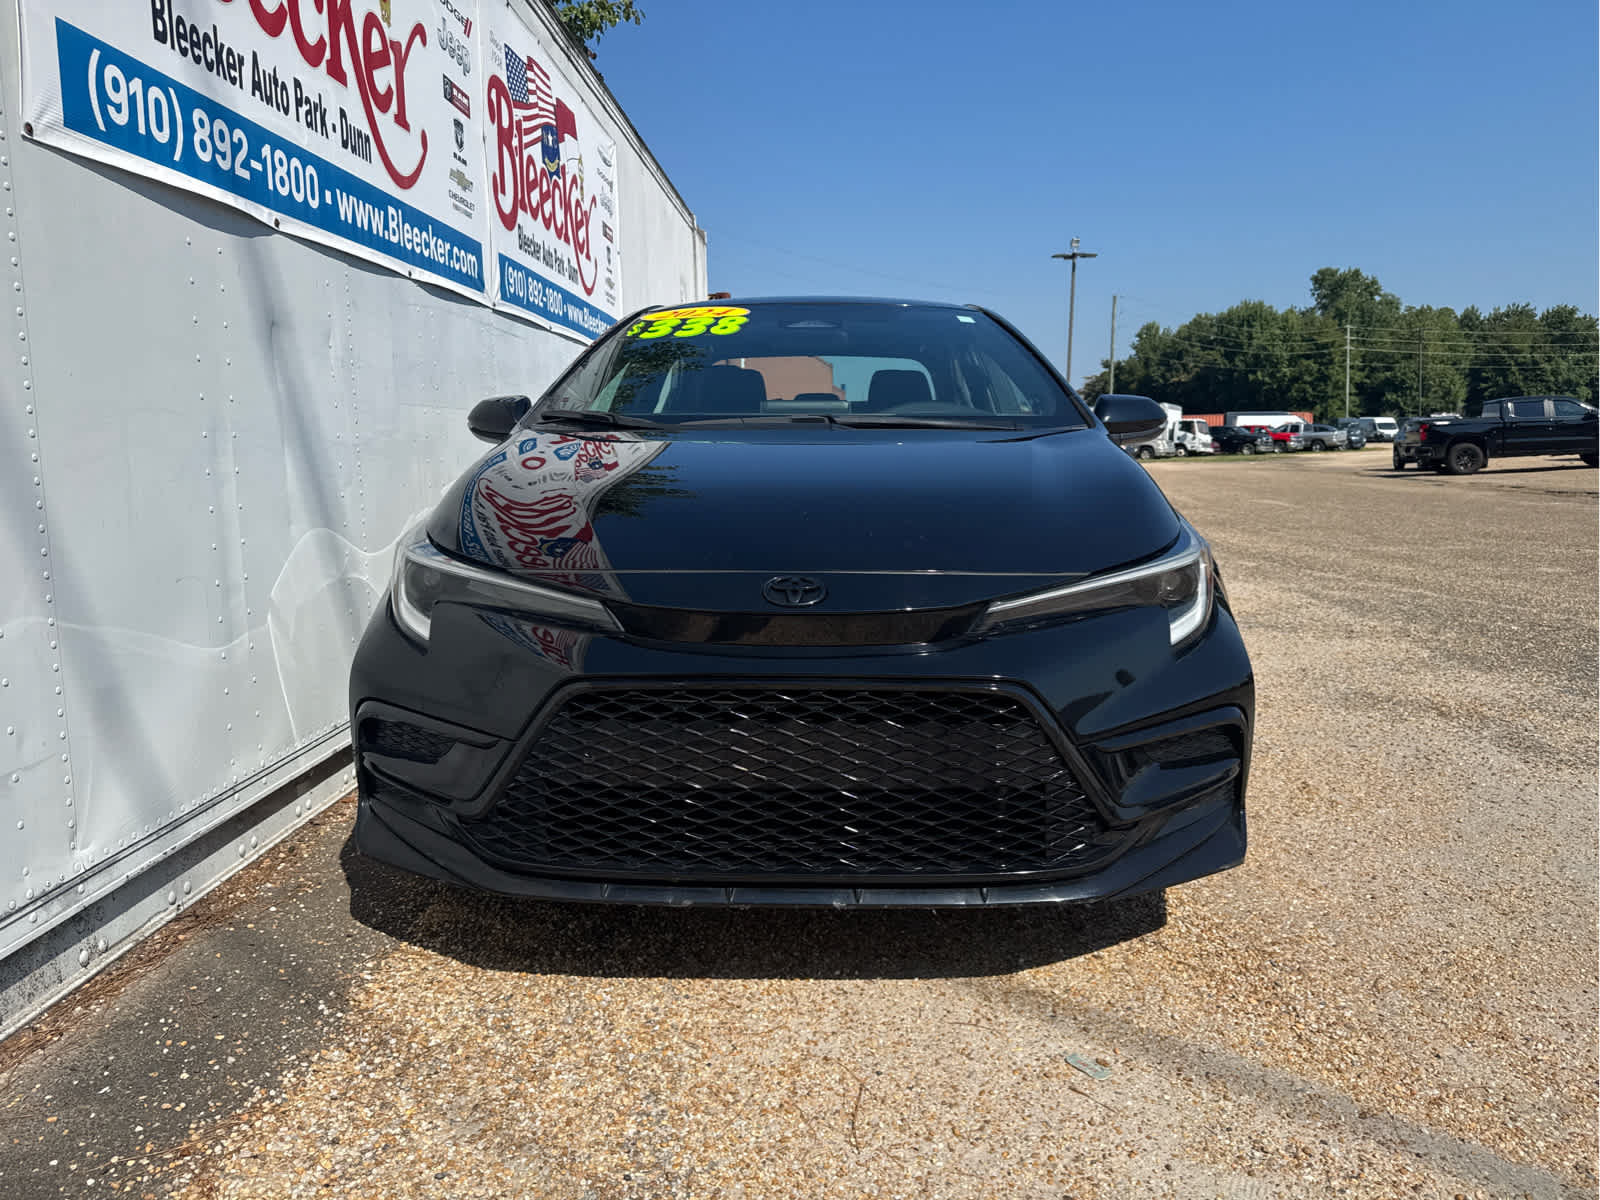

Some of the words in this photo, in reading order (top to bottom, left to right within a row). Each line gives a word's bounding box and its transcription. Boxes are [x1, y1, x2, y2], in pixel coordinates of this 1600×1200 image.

[151, 0, 244, 89] Bleecker
[252, 50, 289, 116] Auto
[293, 77, 328, 139] Park
[340, 107, 372, 164] Dunn
[437, 16, 471, 76] Jeep
[88, 48, 183, 161] (910)
[192, 108, 319, 209] 892-1800
[336, 188, 478, 279] www.Bleecker.com
[487, 74, 597, 296] Bleecker
[505, 261, 527, 304] (910)
[528, 276, 563, 317] 892-1800
[627, 316, 749, 339] $338
